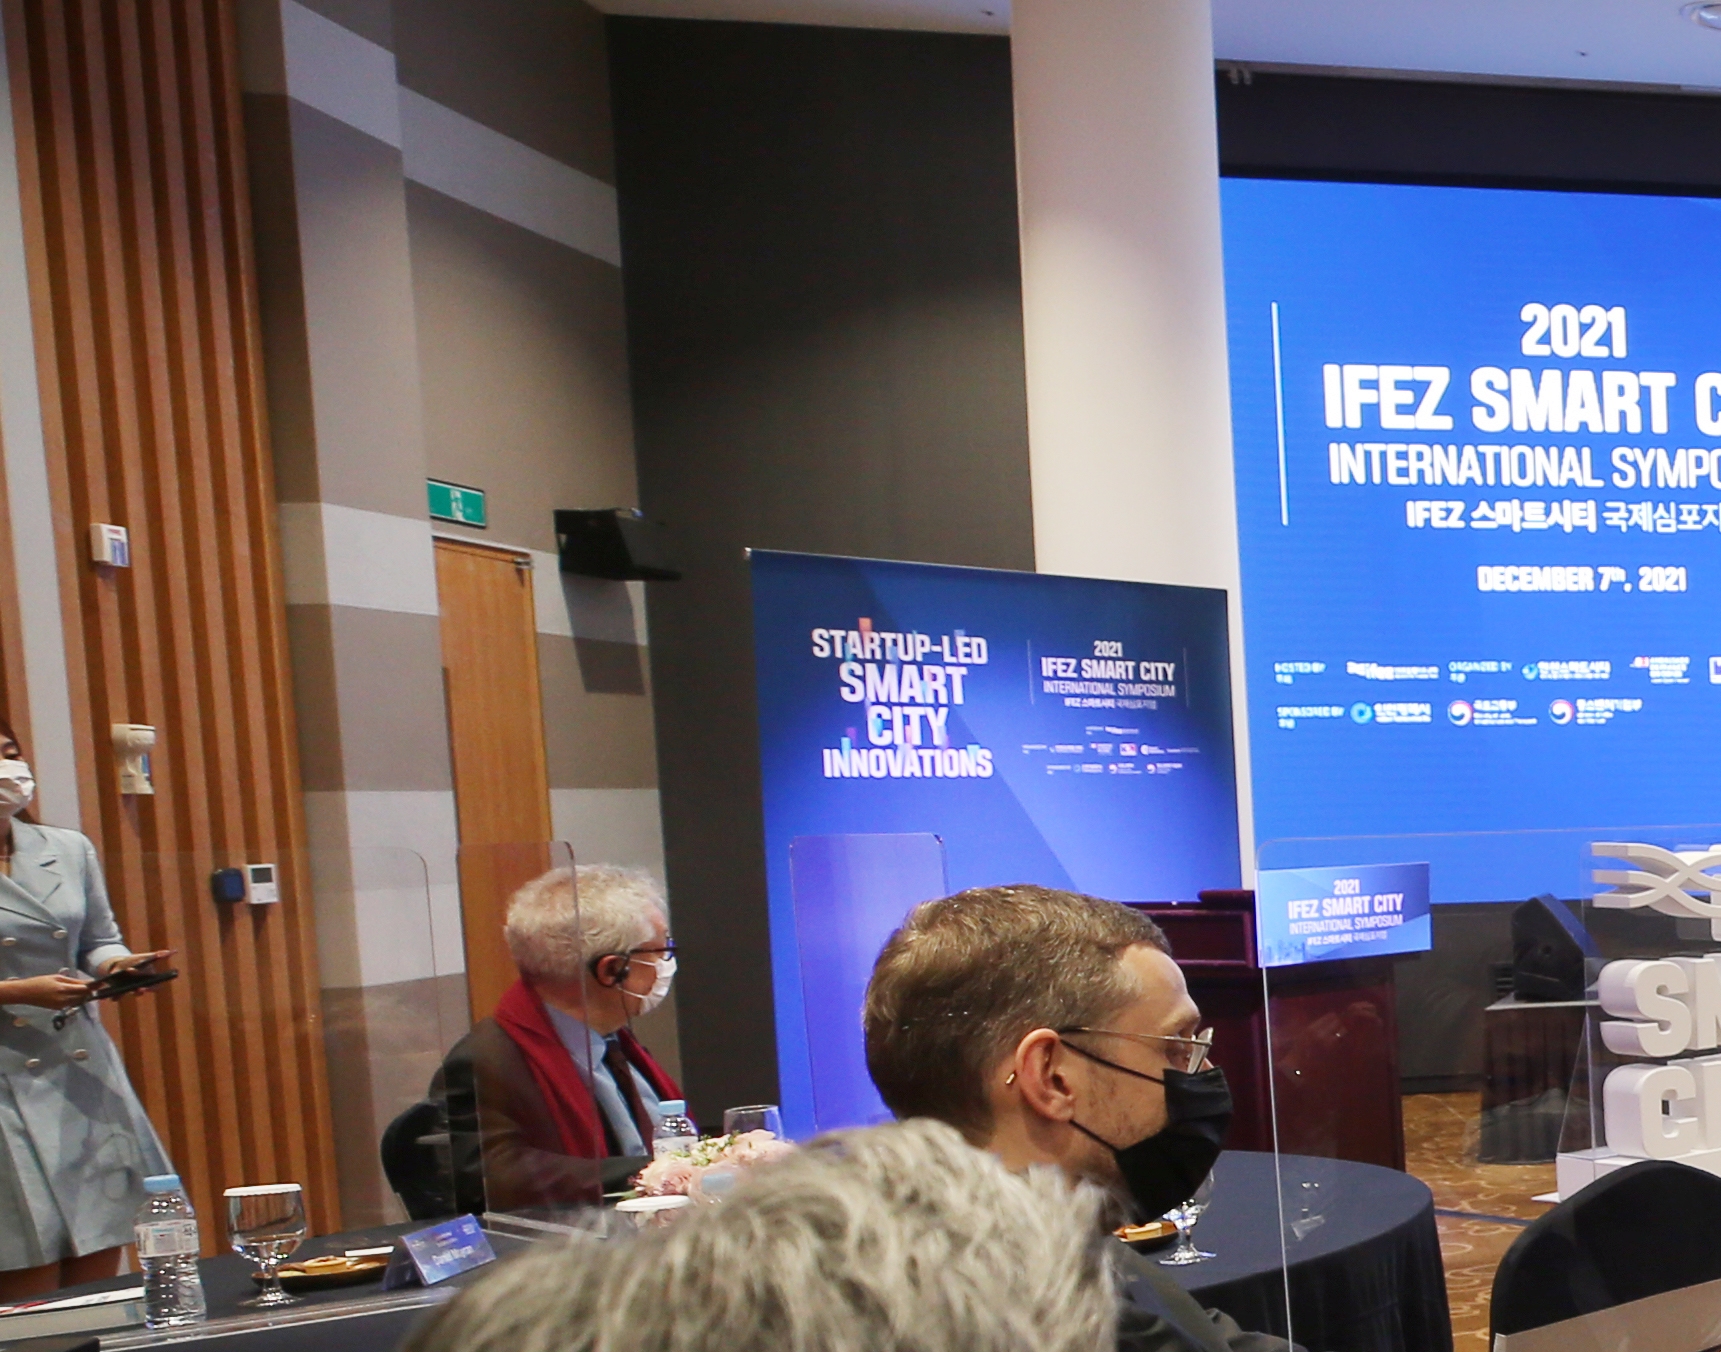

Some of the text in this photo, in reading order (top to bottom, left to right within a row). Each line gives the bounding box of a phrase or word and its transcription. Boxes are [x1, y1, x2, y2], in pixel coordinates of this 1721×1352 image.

[1520, 303, 1627, 358] 2021
[1323, 364, 1454, 431] IFEZ
[1470, 367, 1677, 434] SMART
[1328, 442, 1604, 487] INTERNATIONAL
[1406, 501, 1465, 529] IFEZ
[1469, 500, 1597, 533] 스마트시티
[1477, 566, 1594, 592] DECEMBER
[1638, 567, 1687, 592] 2021
[811, 627, 989, 665] STARTUP-LED
[1094, 640, 1123, 657] 2021
[839, 661, 969, 705] SMART
[1041, 657, 1176, 682] IFEZ SMART CITY
[1043, 680, 1175, 697] INTERNATIONAL SYMPOSIUM
[867, 704, 949, 747] CITY
[822, 748, 994, 778] INNOVATIONS
[1333, 879, 1361, 895] 2021
[1287, 893, 1404, 919] IFEZ SMART CITY
[1289, 914, 1403, 935] INTERNATIONAL SYMPOSIUM
